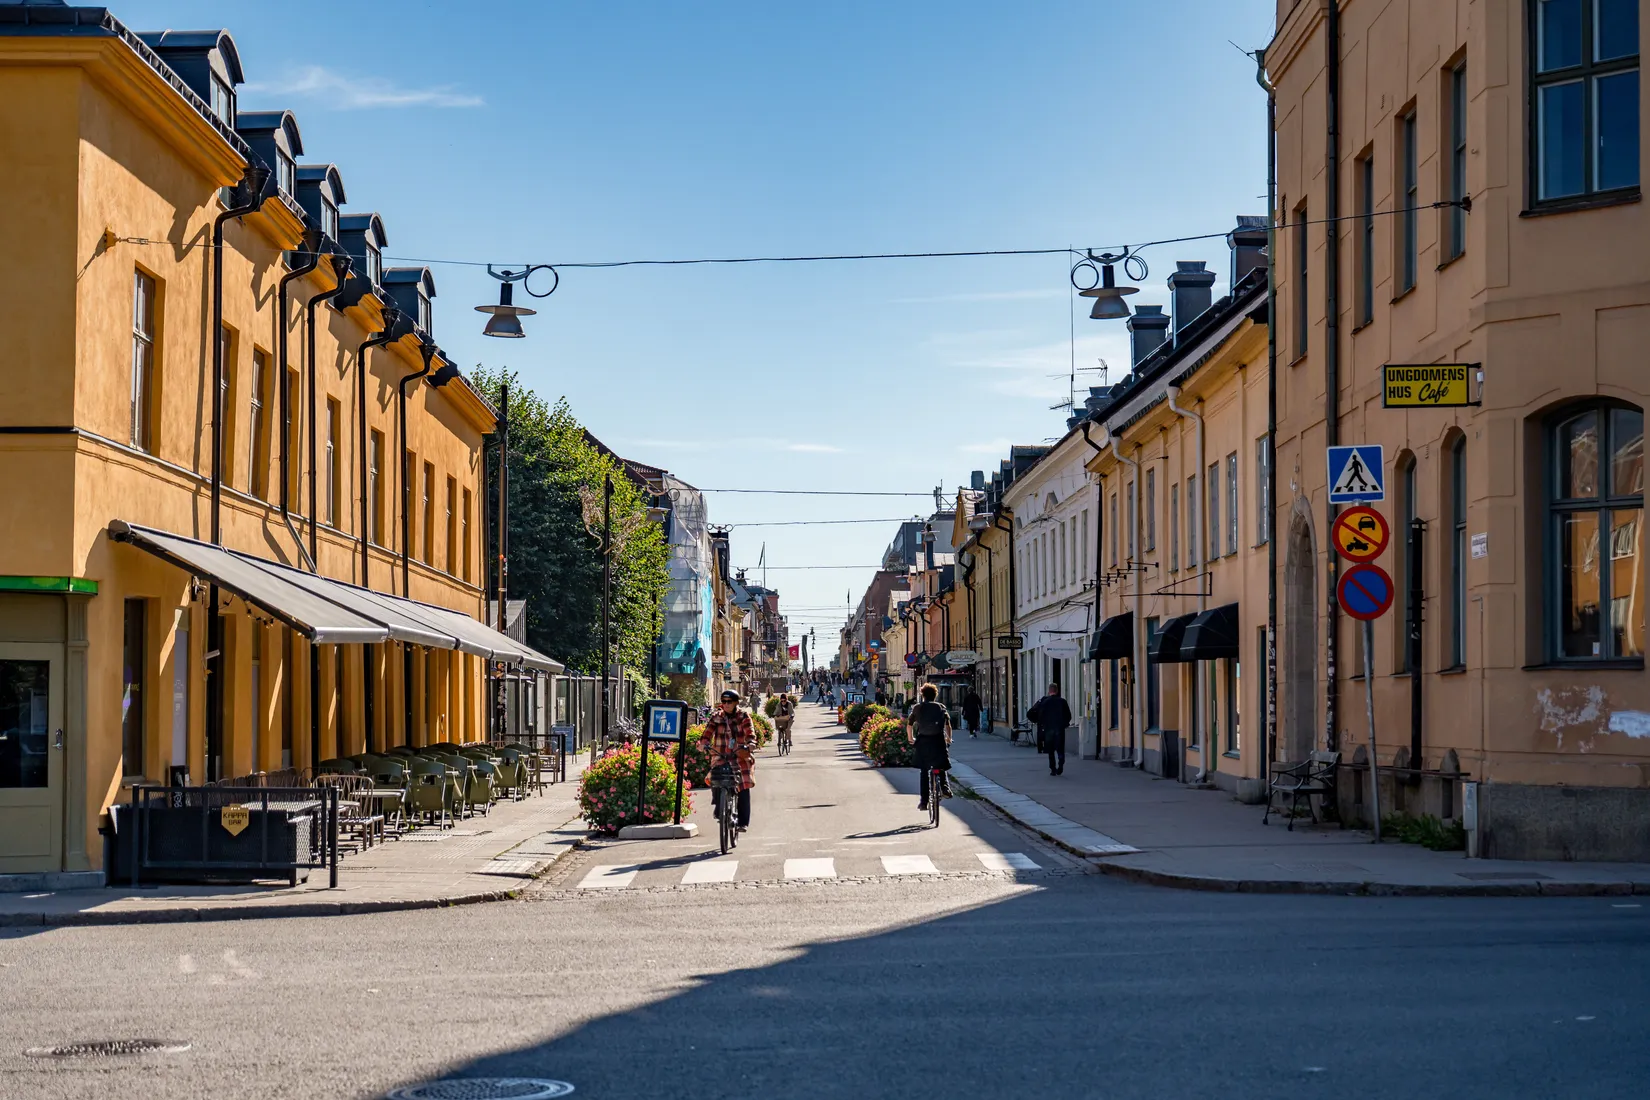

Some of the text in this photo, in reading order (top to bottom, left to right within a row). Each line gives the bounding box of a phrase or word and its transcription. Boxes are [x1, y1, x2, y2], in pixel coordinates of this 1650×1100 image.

[1388, 368, 1465, 382] UNGDOMENS
[1388, 381, 1450, 403] HUS Café
